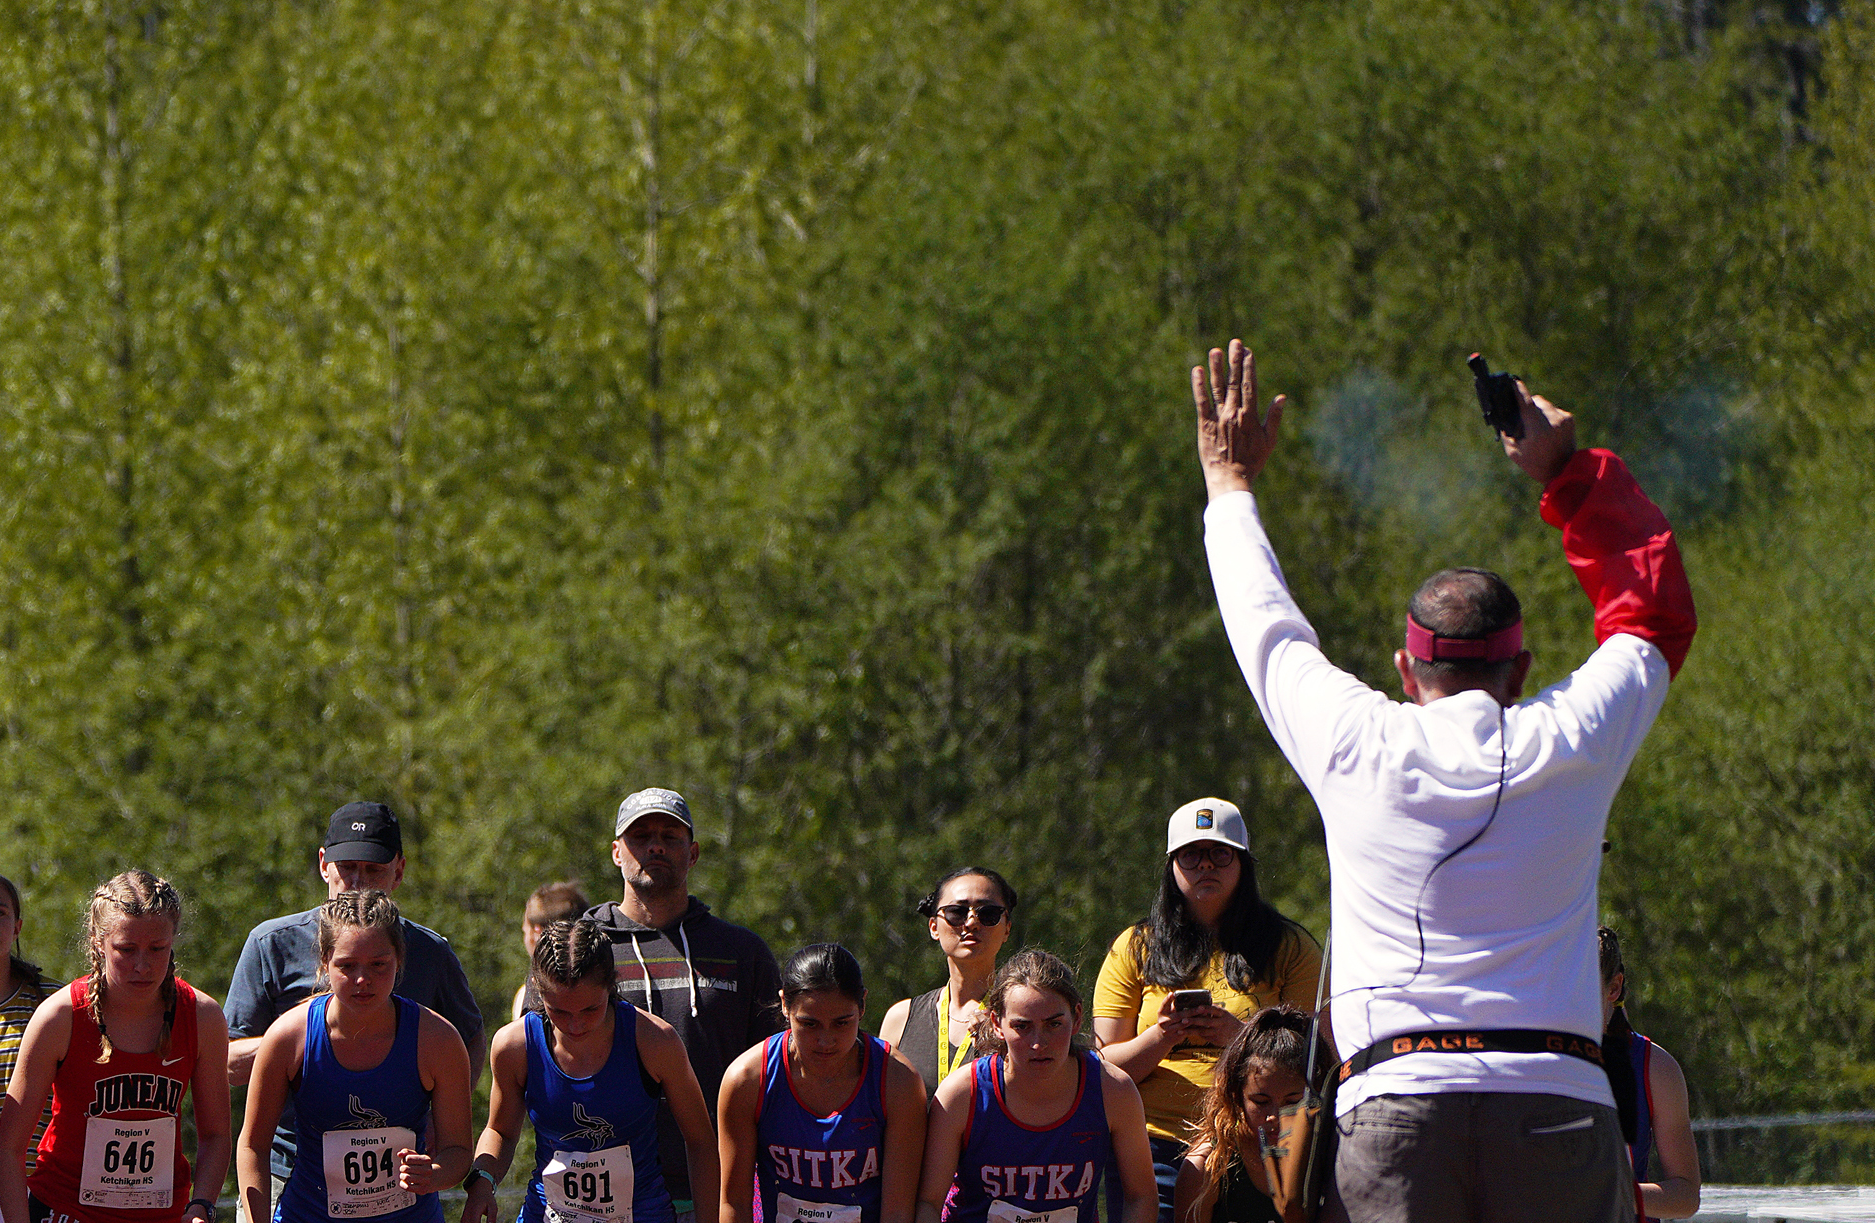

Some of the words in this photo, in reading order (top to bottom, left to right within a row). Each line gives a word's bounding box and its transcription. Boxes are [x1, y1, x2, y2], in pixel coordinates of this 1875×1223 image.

[351, 822, 366, 832] OR
[1392, 1033, 1485, 1055] GAGE
[1545, 1034, 1604, 1064] GAG
[89, 1073, 183, 1118] JUNEAU
[115, 1128, 143, 1138] Region
[144, 1128, 150, 1136] V
[351, 1138, 379, 1146] Region
[381, 1136, 387, 1144] V
[103, 1140, 156, 1174] 646
[571, 1159, 599, 1170] Region
[600, 1158, 606, 1166] V
[343, 1148, 393, 1184] 694
[768, 1144, 880, 1190] SITKA
[101, 1176, 141, 1185] Ketchikan
[142, 1176, 153, 1184] HS
[345, 1185, 385, 1196] Ketchikan
[387, 1180, 397, 1189] HS
[563, 1170, 613, 1204] 691
[980, 1160, 1094, 1201] SITKA
[605, 1206, 615, 1214] HS
[797, 1208, 825, 1218] Region
[827, 1210, 833, 1219] V
[1043, 1214, 1050, 1222] V
